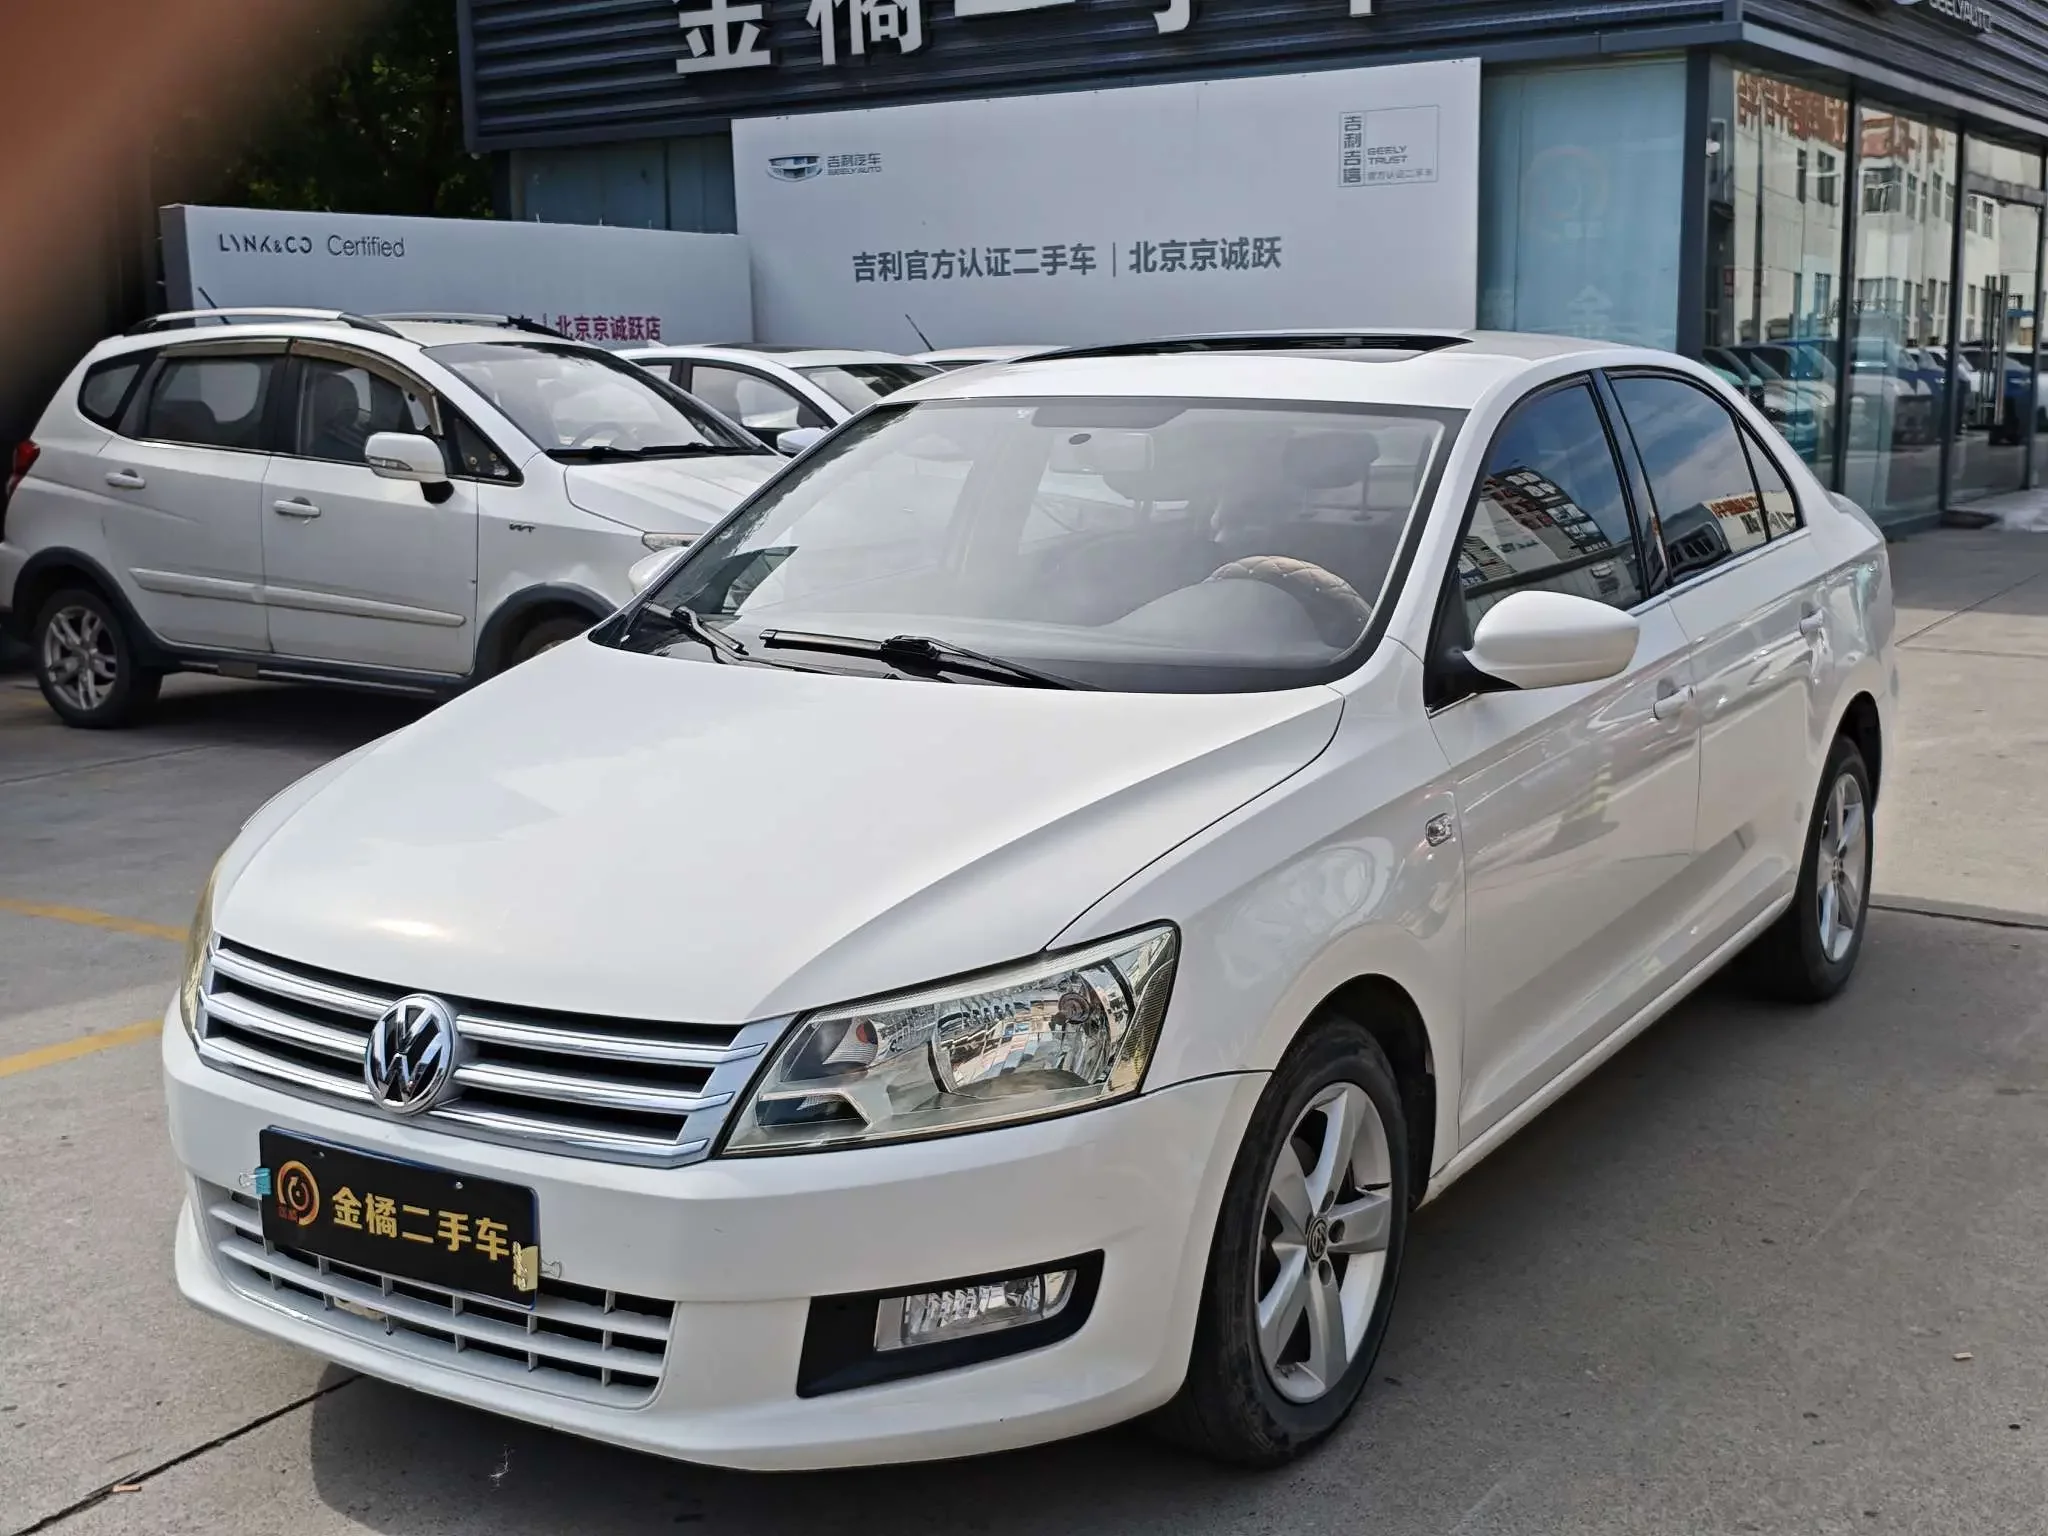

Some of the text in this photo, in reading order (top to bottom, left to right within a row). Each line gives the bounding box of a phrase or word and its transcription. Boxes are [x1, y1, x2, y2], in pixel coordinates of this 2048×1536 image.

[1368, 155, 1408, 165] TRUST
[327, 234, 405, 257] Certified
[852, 236, 1282, 282] 吉利官方认证二手车 北京京诚跃
[555, 314, 661, 341] 北京京诚跃店
[331, 1186, 511, 1261] 金橘二手车
